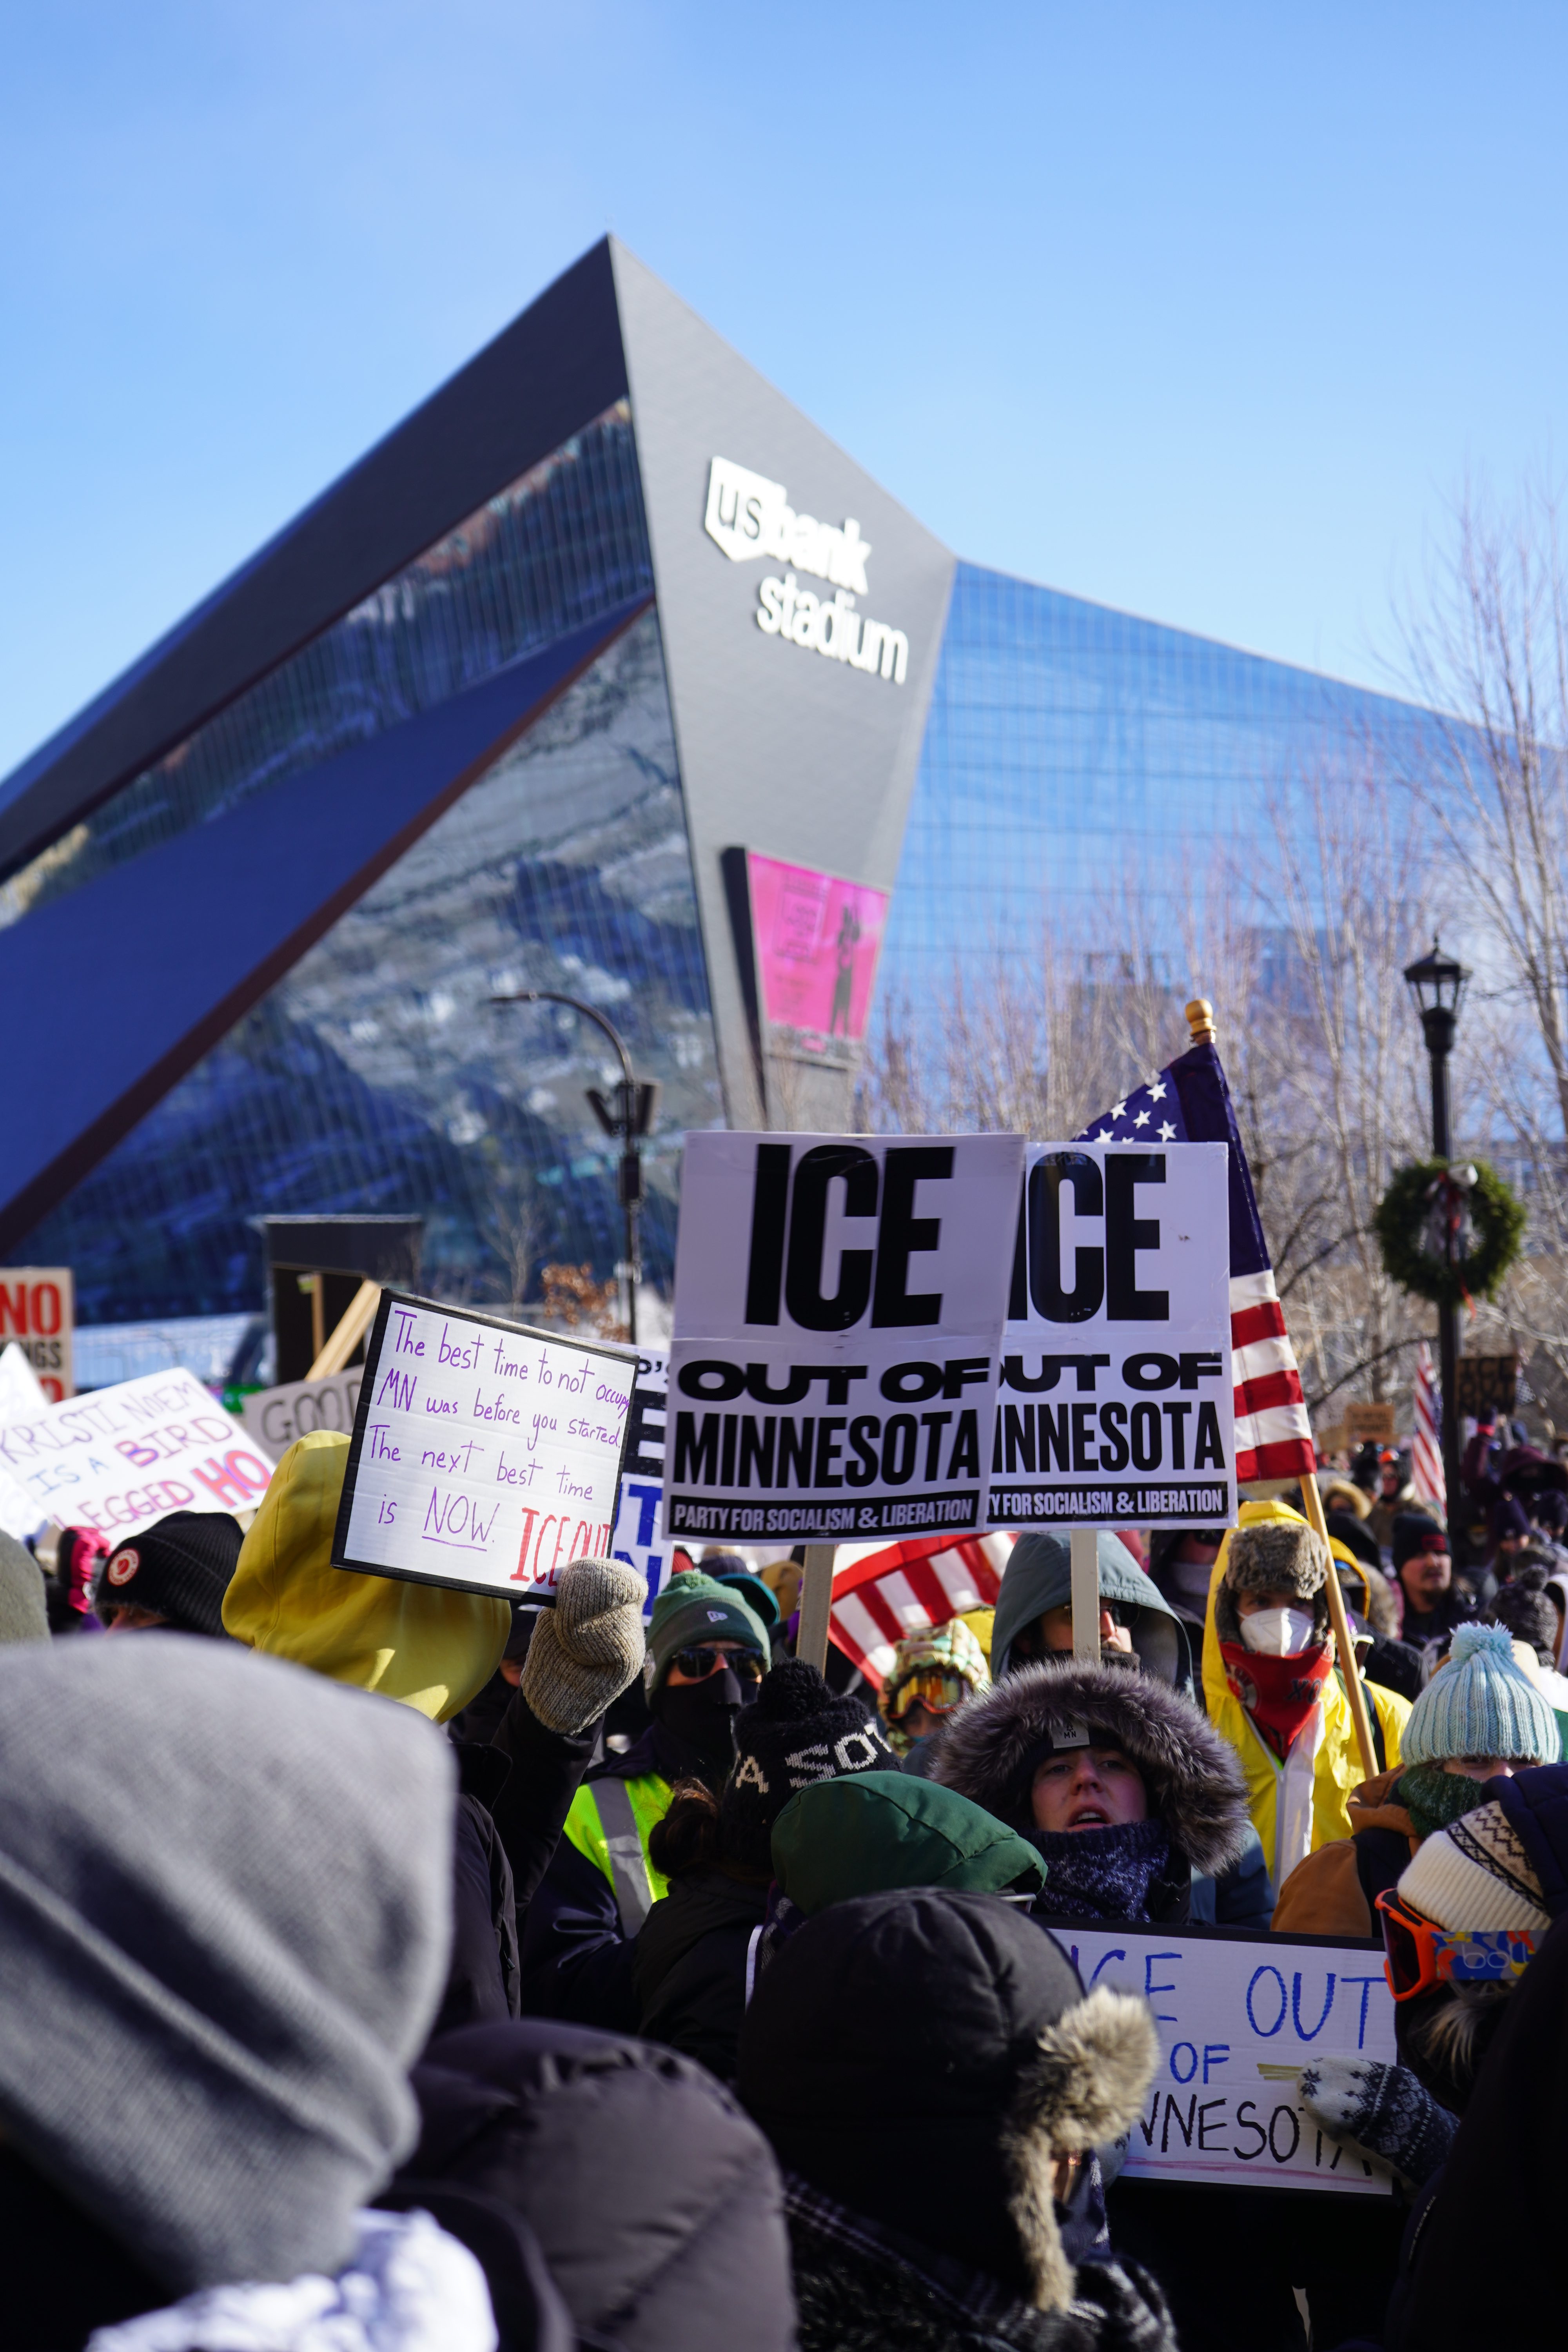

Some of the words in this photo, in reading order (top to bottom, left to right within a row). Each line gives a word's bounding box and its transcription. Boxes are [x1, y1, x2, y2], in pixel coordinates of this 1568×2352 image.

[757, 572, 909, 685] stadium
[744, 1143, 956, 1332] ICE
[0, 1282, 62, 1337] NO
[395, 1310, 425, 1357] The
[438, 1323, 484, 1370] best
[494, 1338, 528, 1380] time
[538, 1348, 552, 1385] to
[558, 1359, 595, 1394] not
[596, 1385, 631, 1420] occupy
[677, 1359, 868, 1405] OUT
[880, 1357, 991, 1403] OF
[997, 1353, 1110, 1393] UT
[1122, 1352, 1222, 1390] OF
[0, 1400, 128, 1465] KRISTI
[121, 1381, 209, 1425] NOEM
[377, 1368, 417, 1413] MN
[426, 1397, 458, 1415] was
[474, 1388, 520, 1426] before
[527, 1414, 557, 1451] you
[567, 1419, 621, 1449] started.
[27, 1464, 81, 1495] IS
[88, 1456, 110, 1474] A
[114, 1416, 233, 1468] BIRD
[369, 1425, 401, 1462] The
[422, 1440, 485, 1475] next
[497, 1451, 544, 1487] best
[556, 1464, 593, 1501] time
[673, 1409, 981, 1489] MINNESOTA
[378, 1494, 397, 1525] is
[674, 1503, 728, 1530] PARTY
[730, 1506, 765, 1532] FOR
[766, 1505, 854, 1532] SOCIALISM
[858, 1506, 880, 1529] &
[882, 1497, 974, 1527] LIBERATION
[1003, 1492, 1032, 1516] FOR
[1034, 1491, 1113, 1516] SOCIALISM
[1116, 1491, 1136, 1514] &
[1138, 1488, 1222, 1514] LIBERATION
[1246, 1965, 1389, 2049] OUT
[1169, 2042, 1230, 2085] OF
